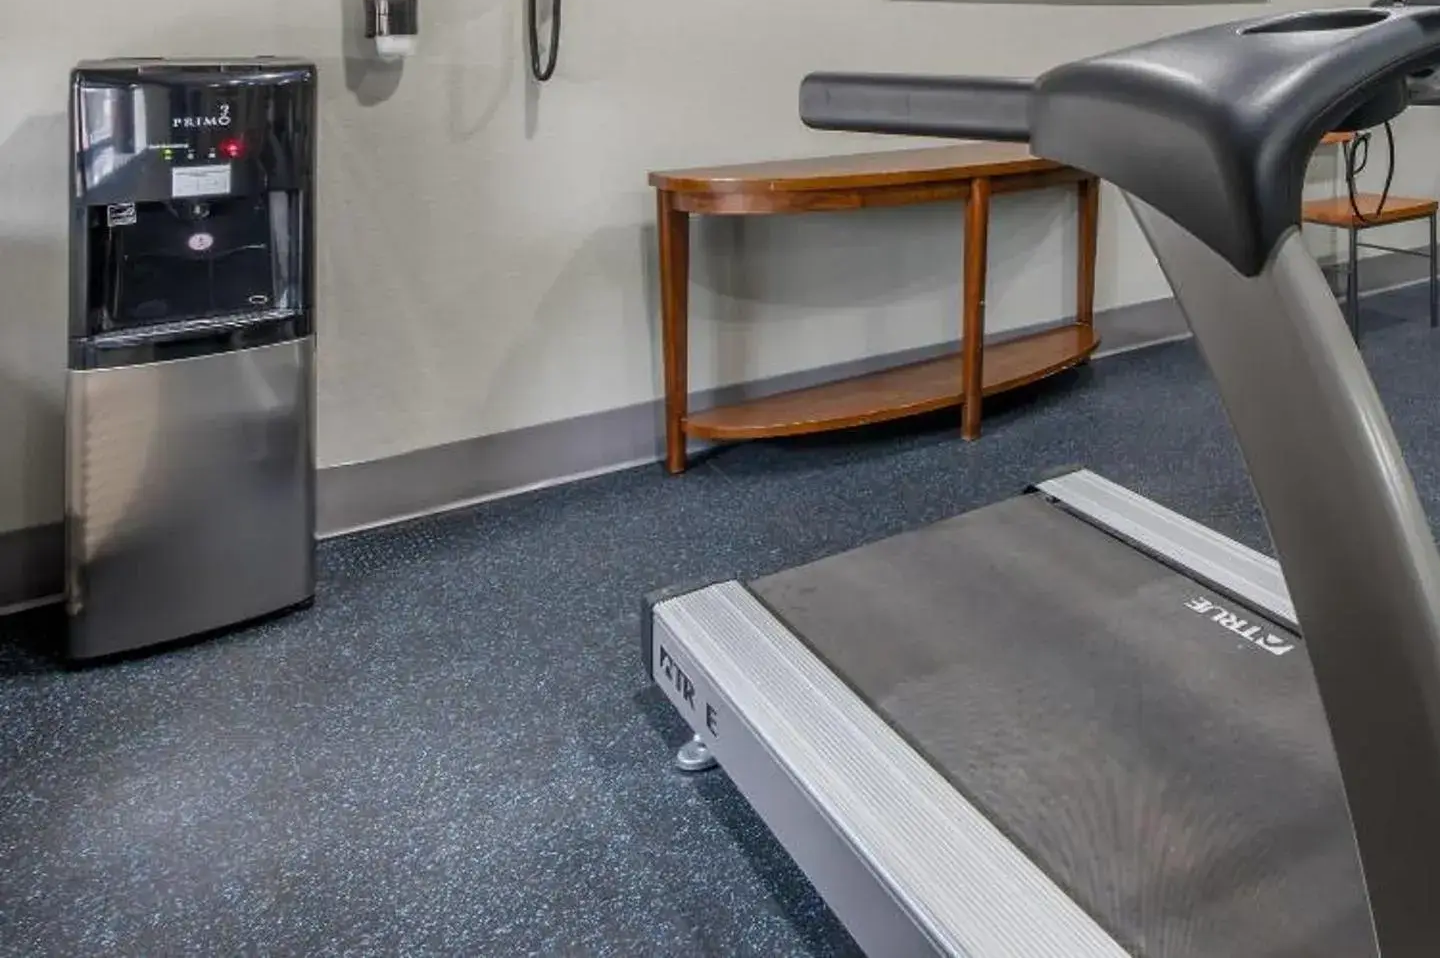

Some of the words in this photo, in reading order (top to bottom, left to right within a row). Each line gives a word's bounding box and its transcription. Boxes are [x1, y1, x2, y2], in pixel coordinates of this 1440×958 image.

[172, 110, 232, 128] PRIMO
[1183, 595, 1262, 642] TRUE
[673, 662, 718, 738] TRE
